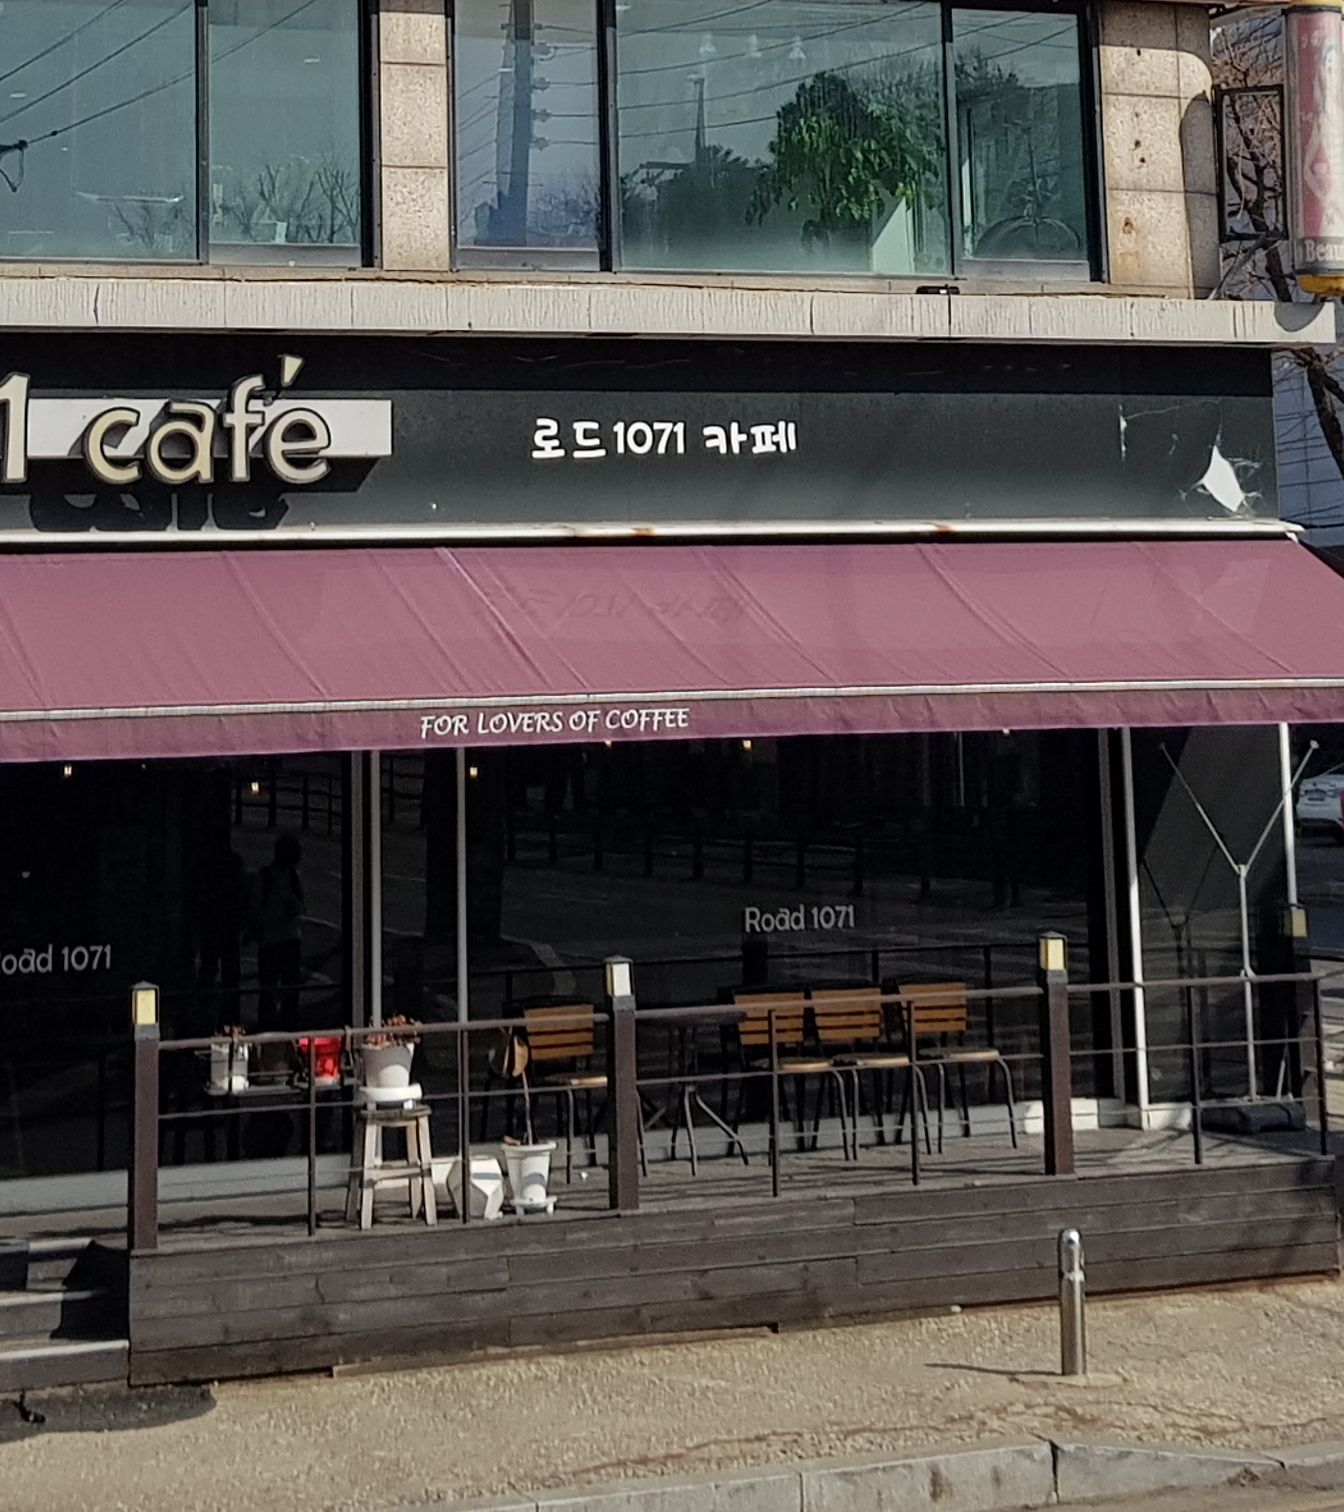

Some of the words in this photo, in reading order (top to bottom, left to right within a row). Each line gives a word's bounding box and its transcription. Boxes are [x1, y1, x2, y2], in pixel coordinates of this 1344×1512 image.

[83, 352, 334, 486] café
[703, 418, 798, 457] 카페
[420, 715, 469, 739] FOR
[477, 711, 563, 734] LOVERS
[568, 710, 601, 733] OF
[606, 707, 690, 731] COFFEE
[744, 904, 805, 932] Road
[810, 904, 854, 928] 1071
[61, 944, 111, 972] 1071
